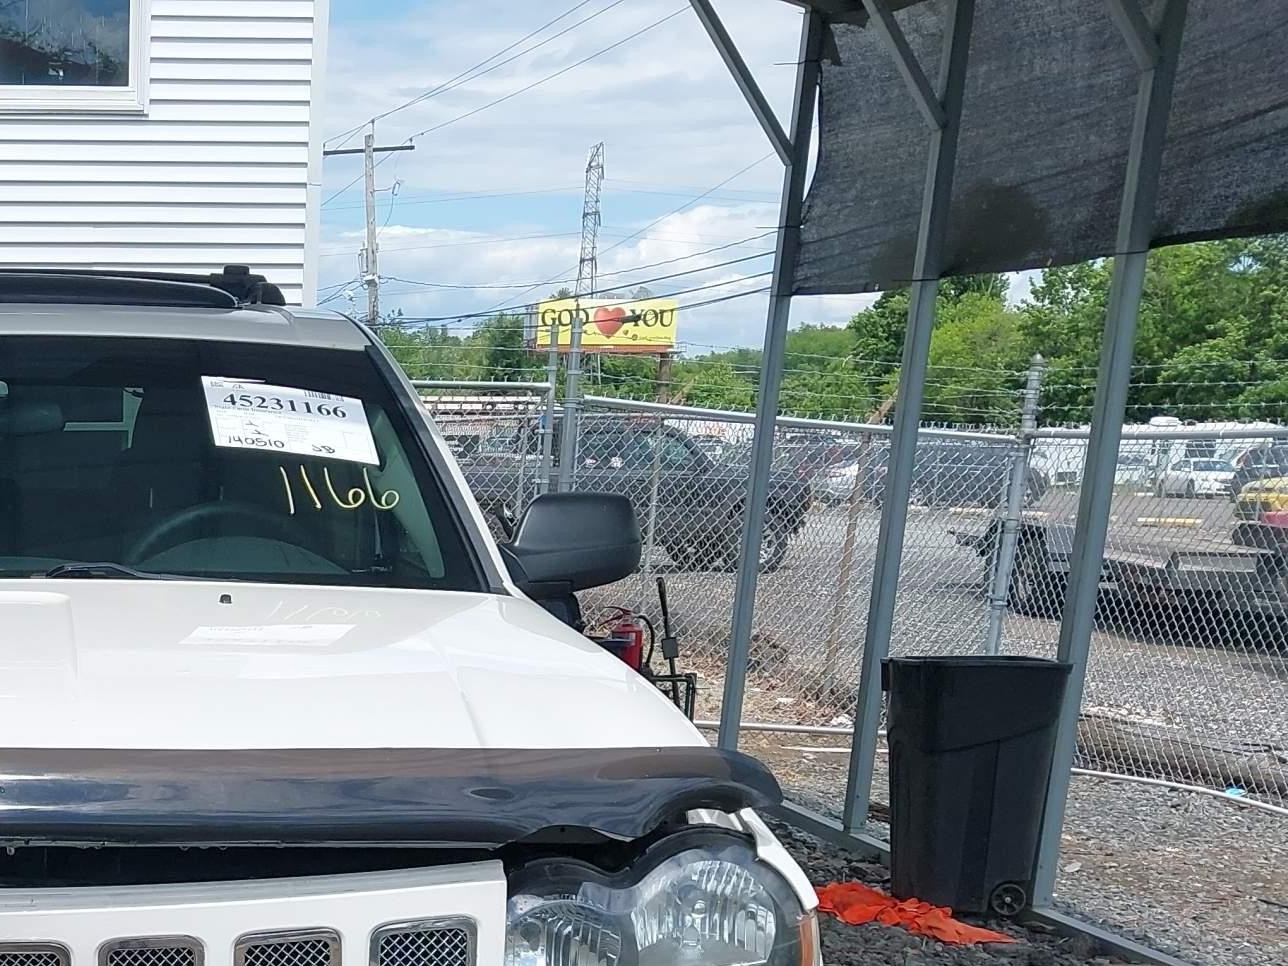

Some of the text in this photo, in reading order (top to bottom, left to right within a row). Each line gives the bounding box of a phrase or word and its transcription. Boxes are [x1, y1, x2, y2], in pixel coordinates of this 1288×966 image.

[541, 308, 674, 327] GOD YOU
[223, 392, 347, 419] 45231166
[279, 464, 401, 515] 1166
